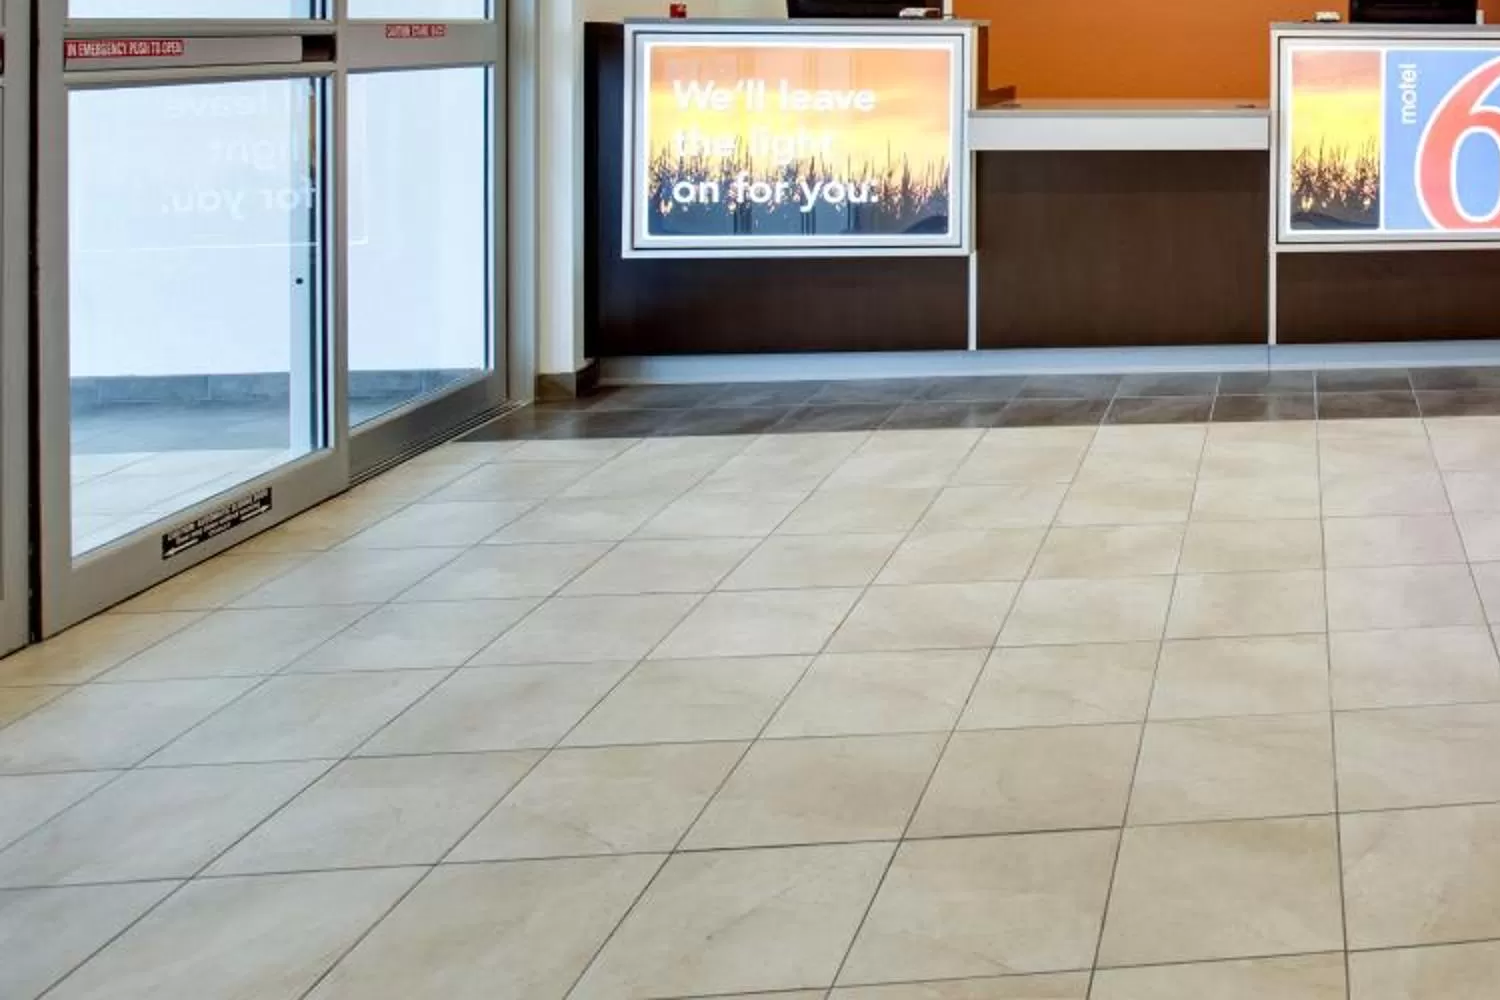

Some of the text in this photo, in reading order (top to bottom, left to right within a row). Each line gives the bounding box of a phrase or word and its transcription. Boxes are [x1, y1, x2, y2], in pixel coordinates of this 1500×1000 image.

[79, 42, 127, 57] EMERGENCY
[672, 78, 877, 112] We'll leave
[1397, 63, 1417, 125] motel
[675, 125, 834, 166] the light
[672, 170, 879, 214] on for you.
